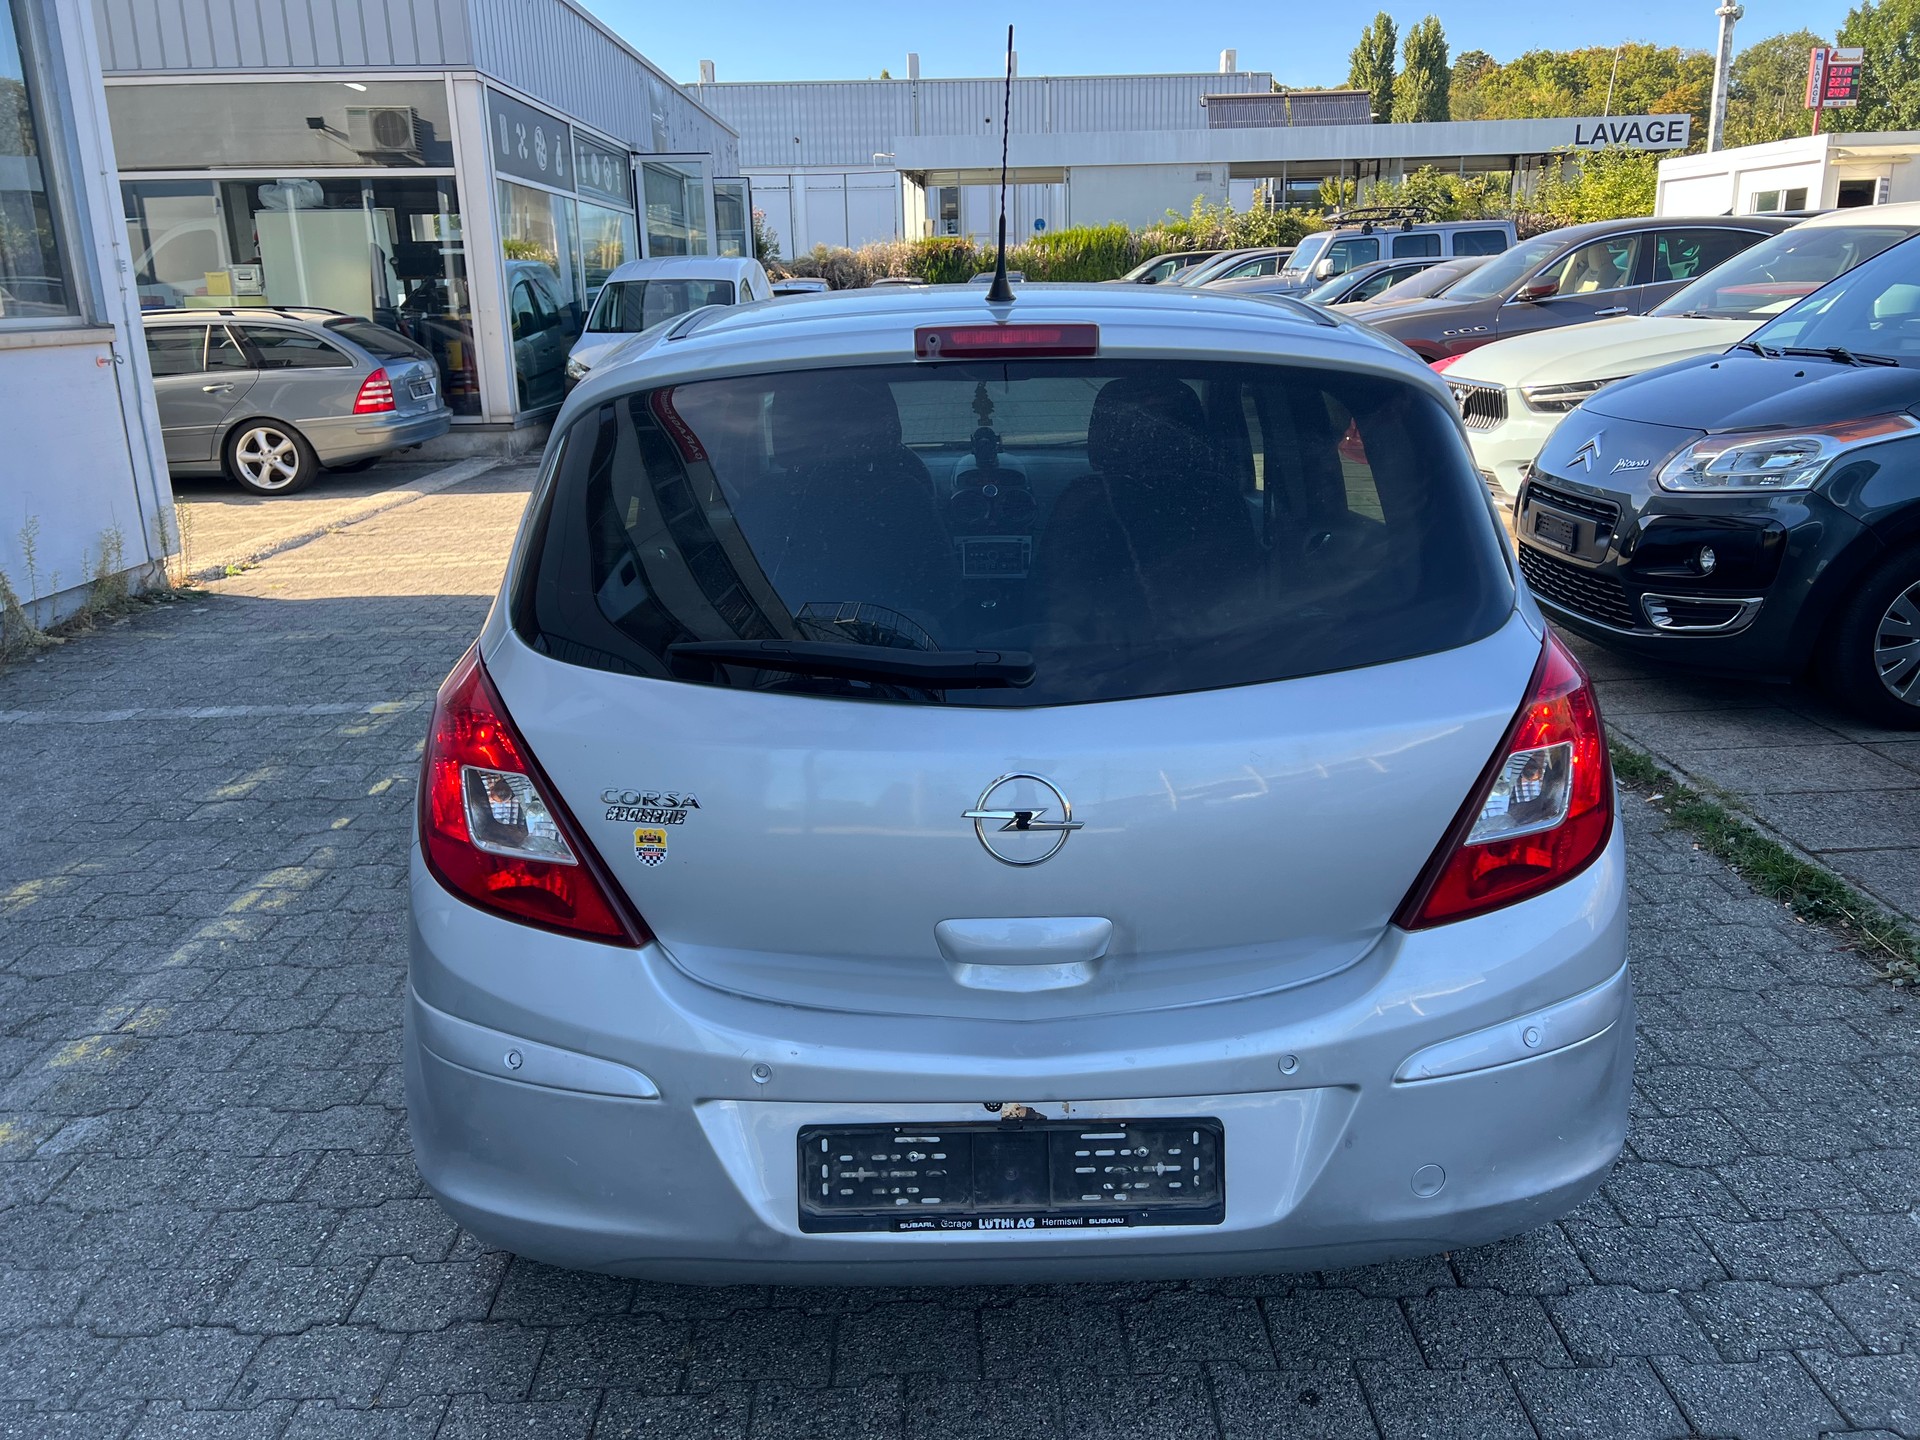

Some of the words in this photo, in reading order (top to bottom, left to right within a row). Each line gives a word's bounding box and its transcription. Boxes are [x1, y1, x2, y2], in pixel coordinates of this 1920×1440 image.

[1812, 64, 1821, 103] LAVAGE
[1575, 120, 1684, 145] LAVAGE
[600, 787, 702, 809] CORSA
[941, 1219, 973, 1229] Garage
[1017, 1217, 1036, 1229] AG
[1041, 1217, 1083, 1226] Hermiswil
[1088, 1217, 1125, 1225] SUBARU
